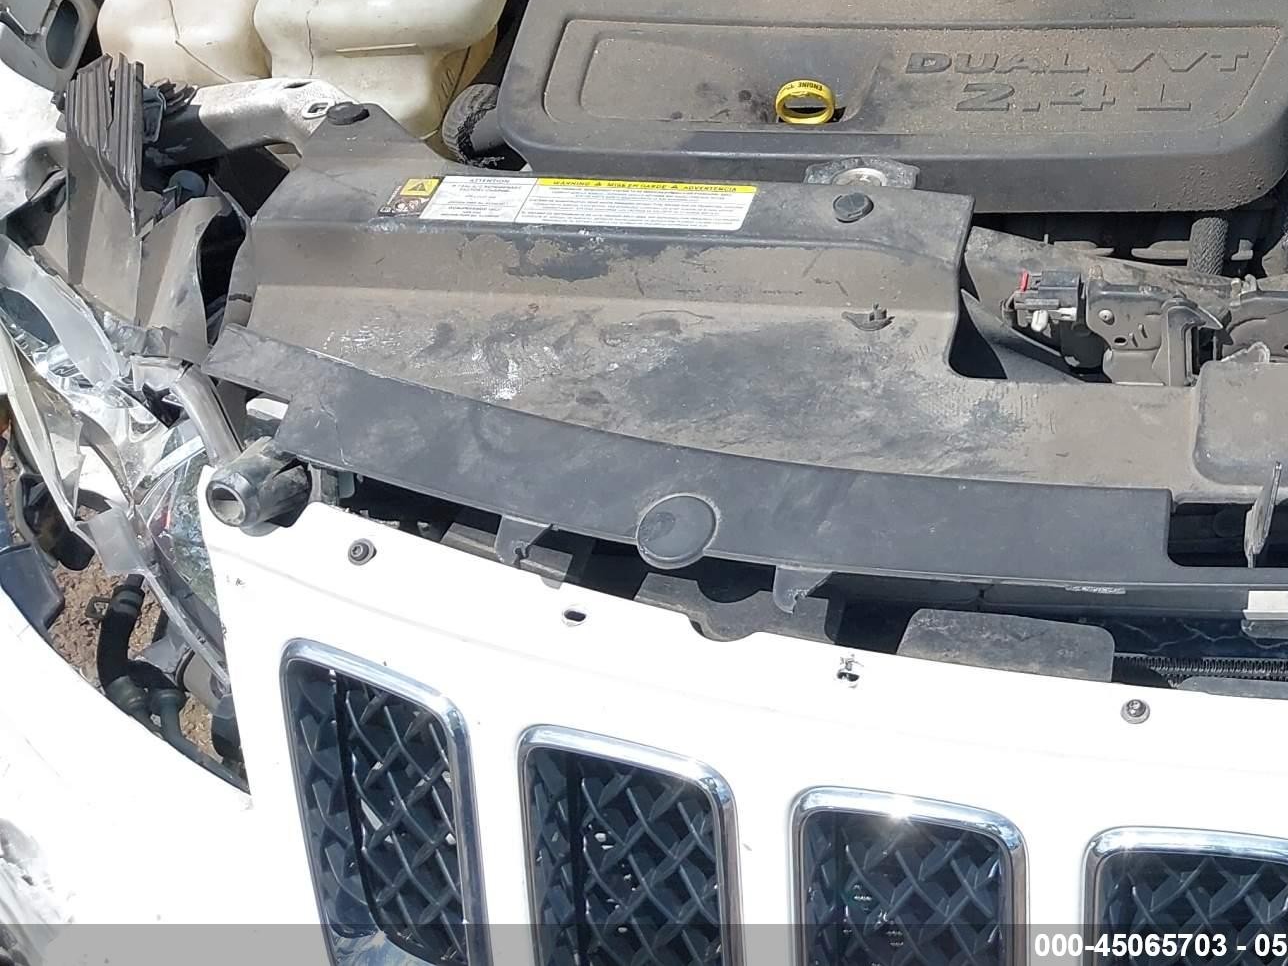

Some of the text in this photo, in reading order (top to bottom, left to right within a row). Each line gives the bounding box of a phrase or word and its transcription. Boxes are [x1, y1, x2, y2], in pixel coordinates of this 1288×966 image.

[904, 51, 1250, 75] DUAL VVT
[954, 82, 1193, 113] 2.4L
